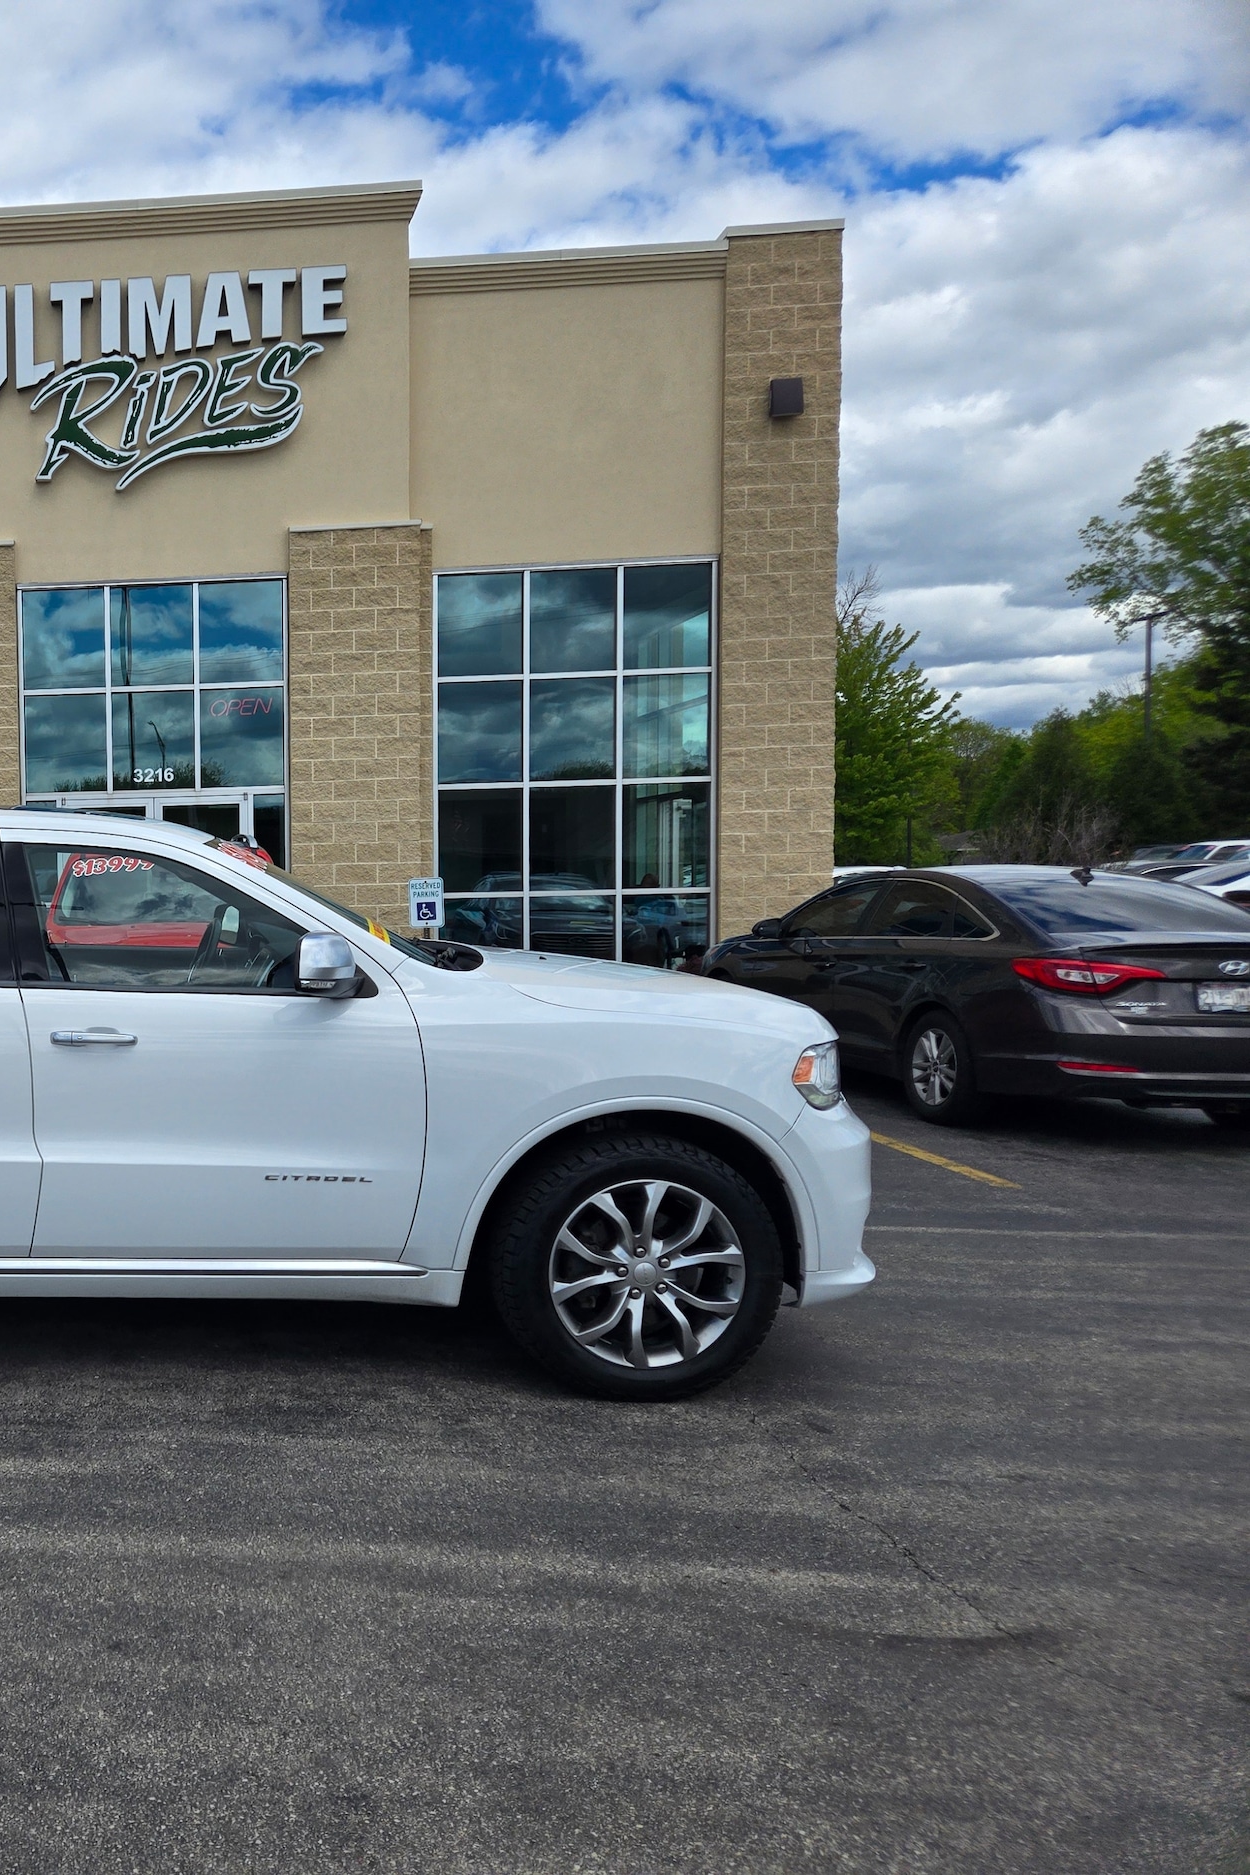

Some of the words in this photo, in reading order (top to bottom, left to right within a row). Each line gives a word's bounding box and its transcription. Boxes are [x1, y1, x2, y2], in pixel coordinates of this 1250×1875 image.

[210, 698, 273, 717] OPEN
[133, 767, 175, 783] 3216
[410, 882, 441, 890] RESERVED
[264, 1175, 373, 1183] CITADEL
